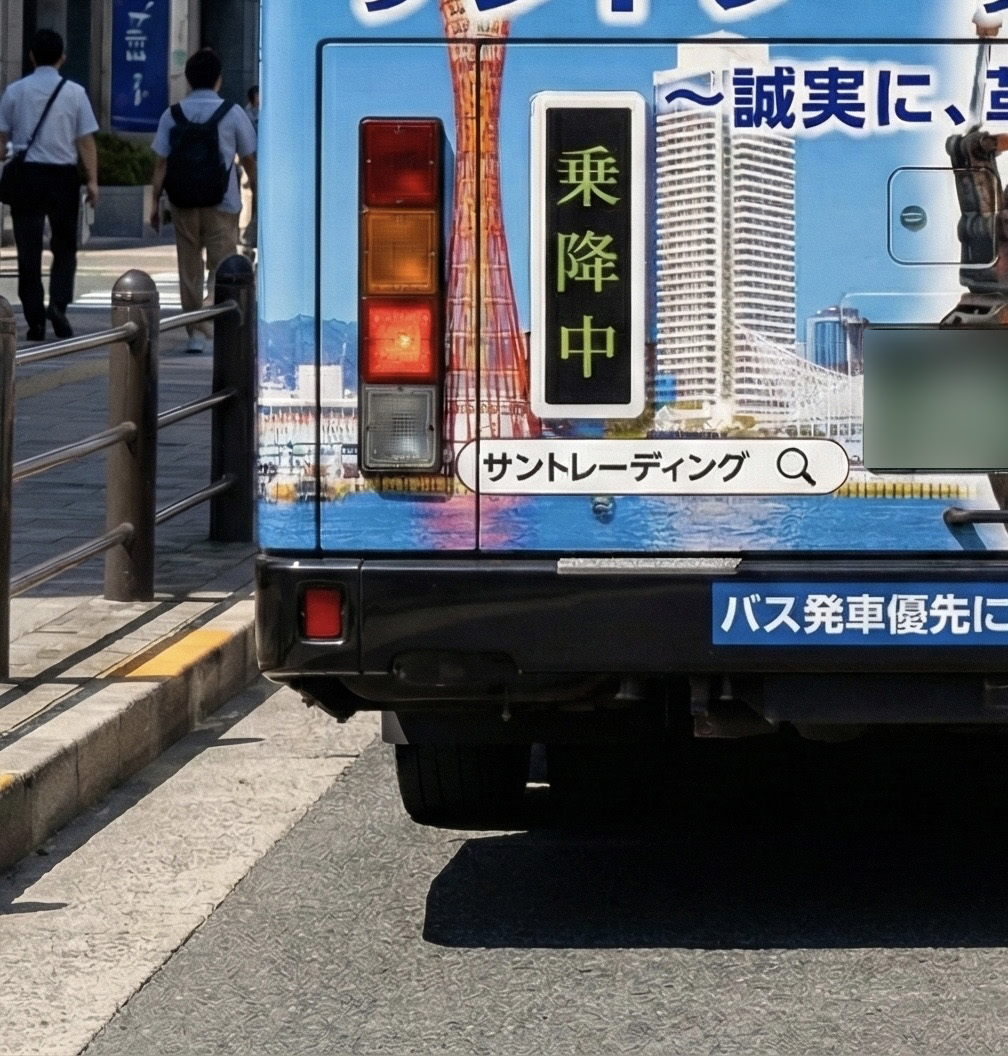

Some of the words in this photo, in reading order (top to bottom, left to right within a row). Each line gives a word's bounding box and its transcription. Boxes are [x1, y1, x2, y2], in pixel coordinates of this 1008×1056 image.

[556, 144, 621, 379] 乗降中
[482, 450, 751, 483] サントレーディング
